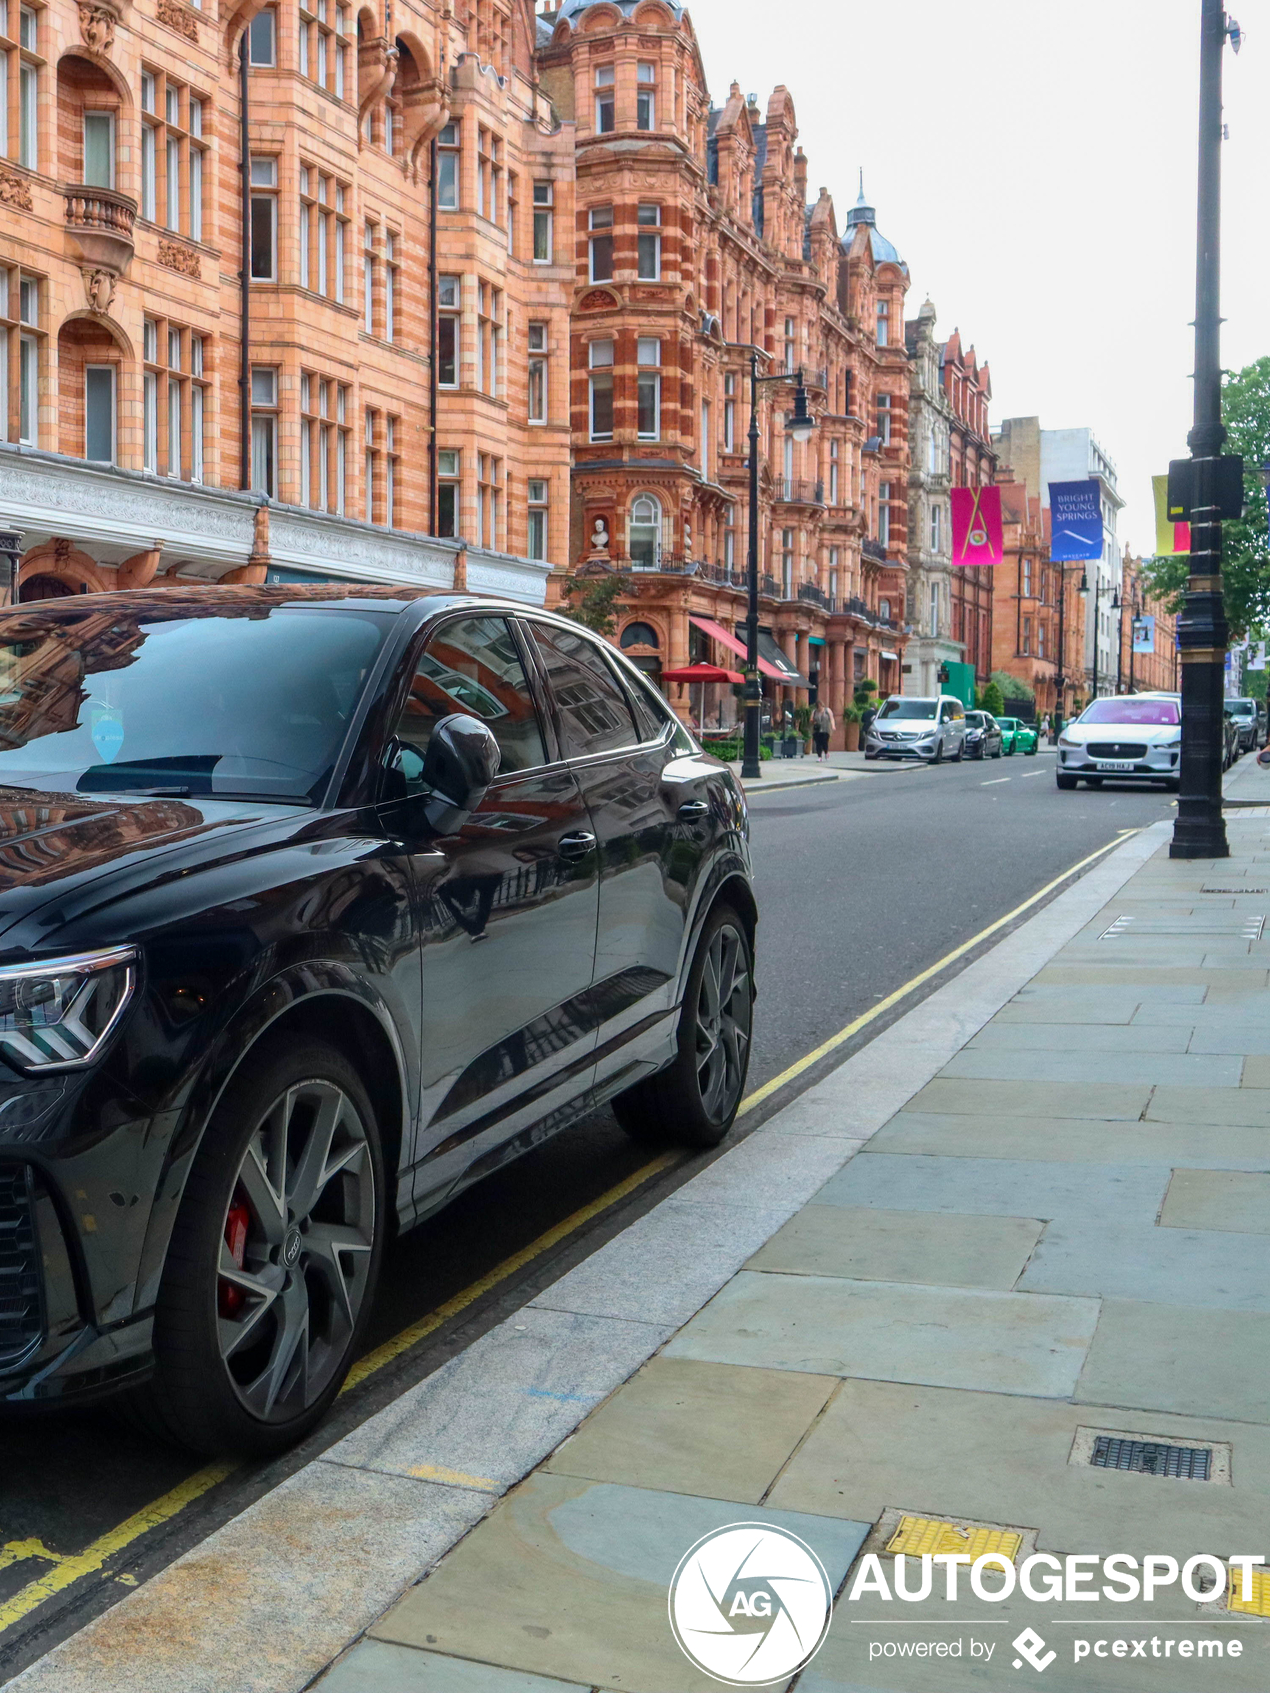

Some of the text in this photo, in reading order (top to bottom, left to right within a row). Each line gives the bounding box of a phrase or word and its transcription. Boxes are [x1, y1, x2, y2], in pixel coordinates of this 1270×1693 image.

[1057, 493, 1094, 503] BRIGHT
[1058, 502, 1095, 512] YOUNG
[1056, 511, 1098, 521] SPRINGS
